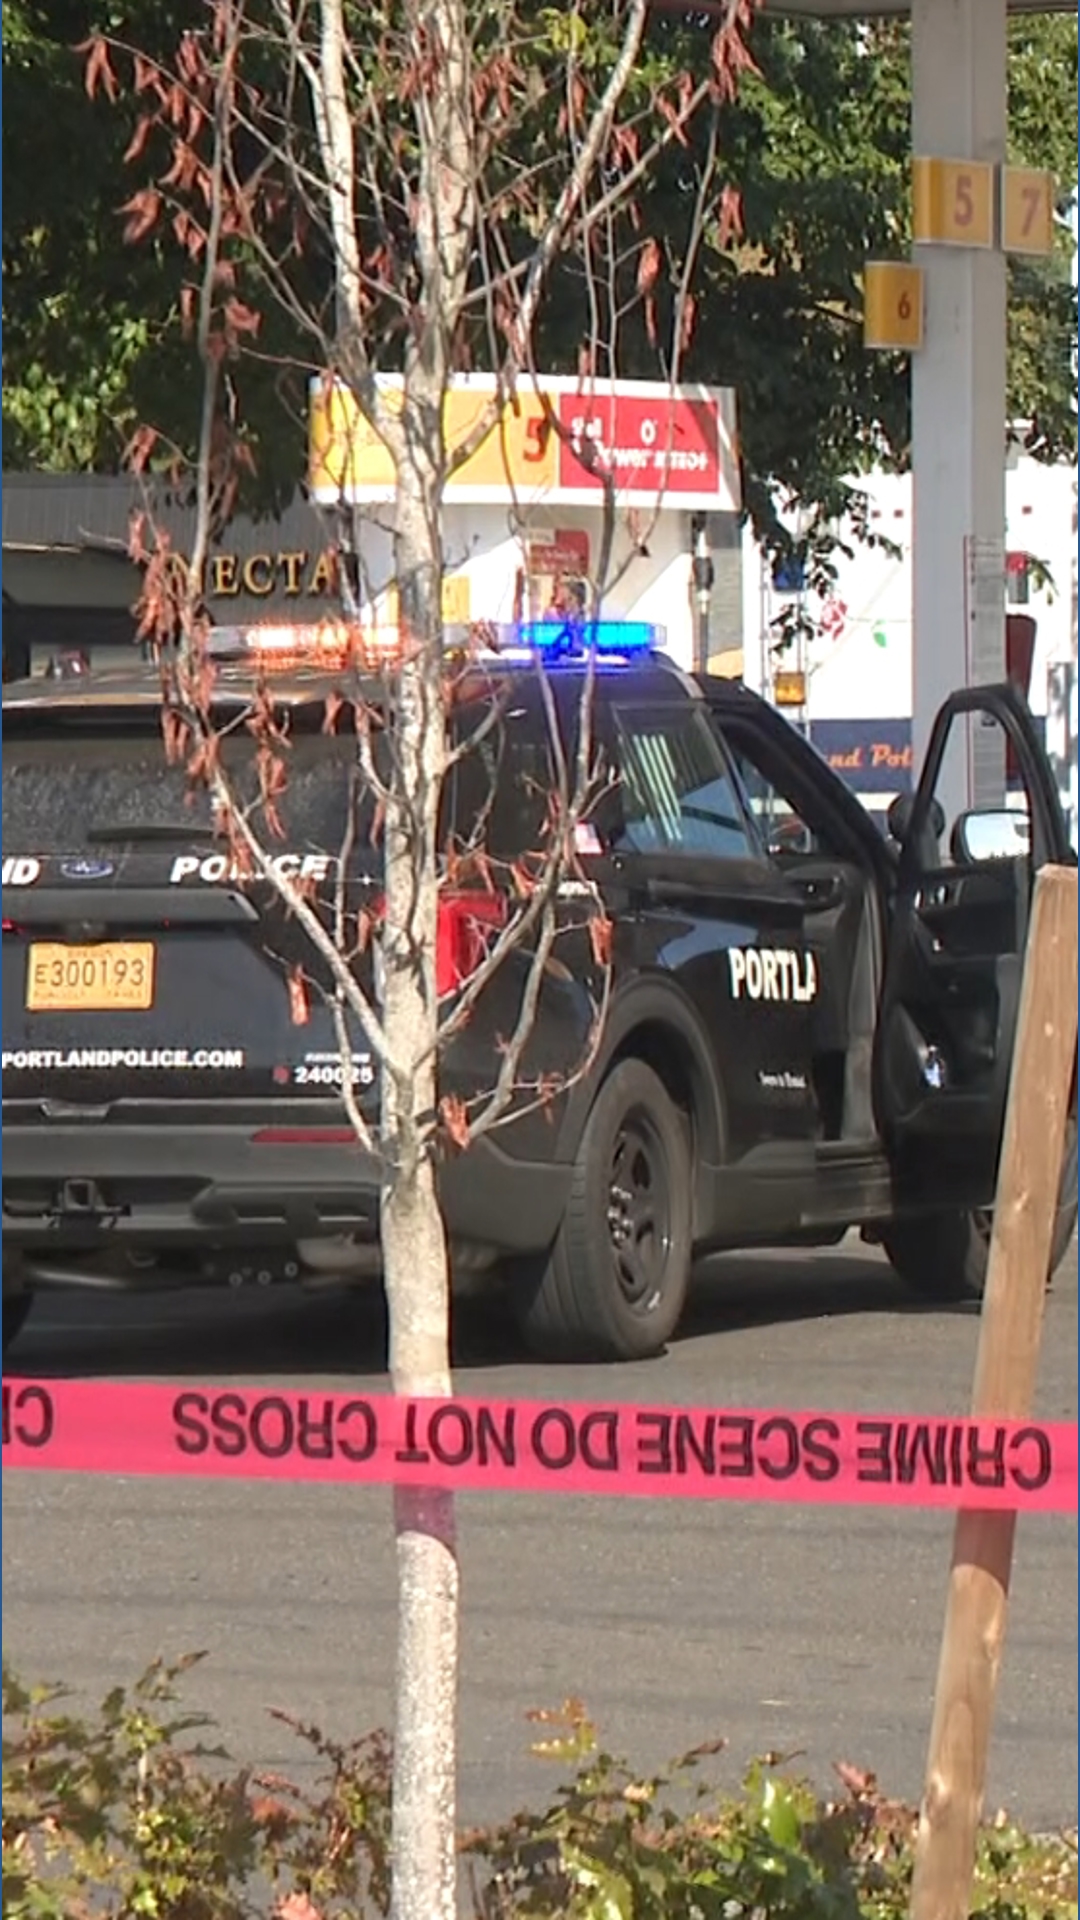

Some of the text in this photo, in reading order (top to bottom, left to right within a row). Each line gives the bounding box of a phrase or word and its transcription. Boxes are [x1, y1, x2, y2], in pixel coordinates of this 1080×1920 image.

[953, 174, 974, 227] 5
[1021, 187, 1041, 237] 7
[897, 290, 912, 320] 6
[523, 417, 550, 462] 5
[169, 854, 328, 883] POLCE
[35, 958, 145, 987] E300193
[2, 1049, 244, 1069] PORTLANDPOLICE.COM
[172, 1392, 378, 1463] CROSS
[395, 1403, 516, 1467] NOT
[530, 1407, 619, 1472] DO
[635, 1412, 841, 1482] SCENE
[856, 1421, 1052, 1492] CRIME
